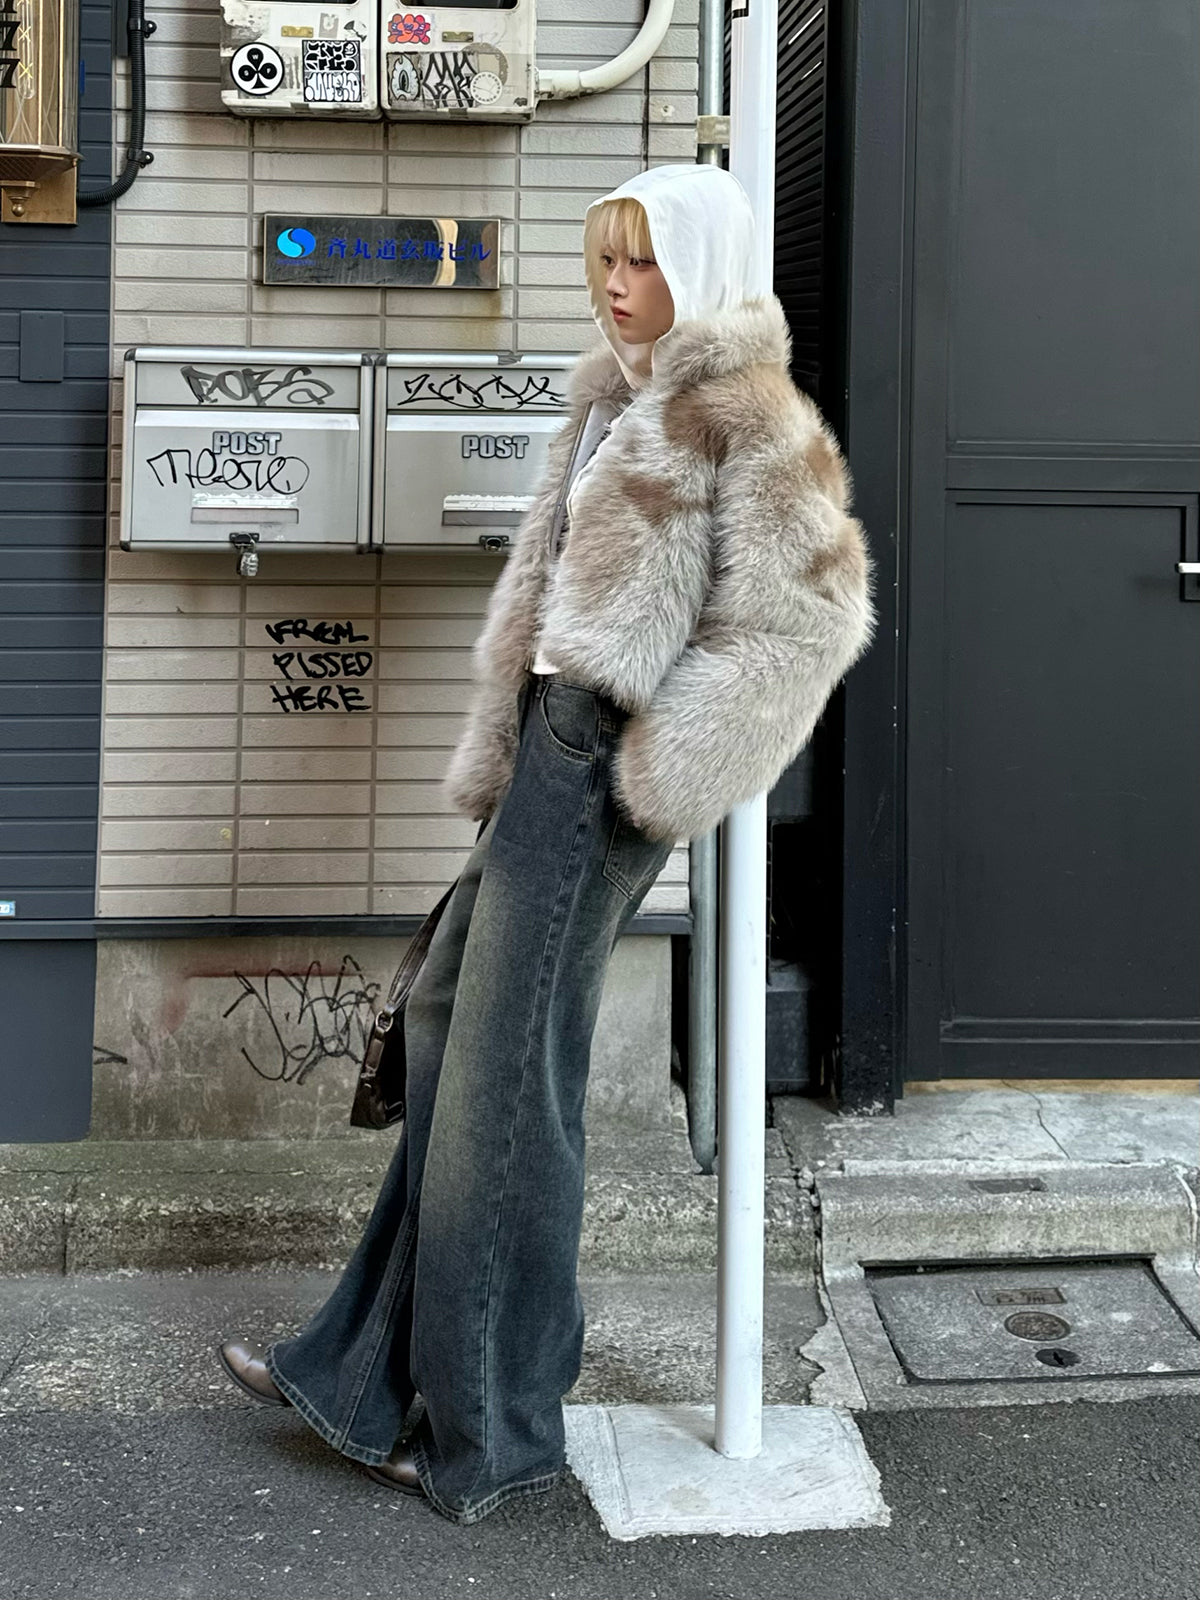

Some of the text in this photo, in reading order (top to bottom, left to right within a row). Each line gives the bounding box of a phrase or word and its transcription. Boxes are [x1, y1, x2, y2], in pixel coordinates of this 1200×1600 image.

[212, 431, 281, 455] POST
[461, 435, 529, 459] POST
[272, 652, 373, 682] PISSED
[270, 684, 372, 713] HERE
